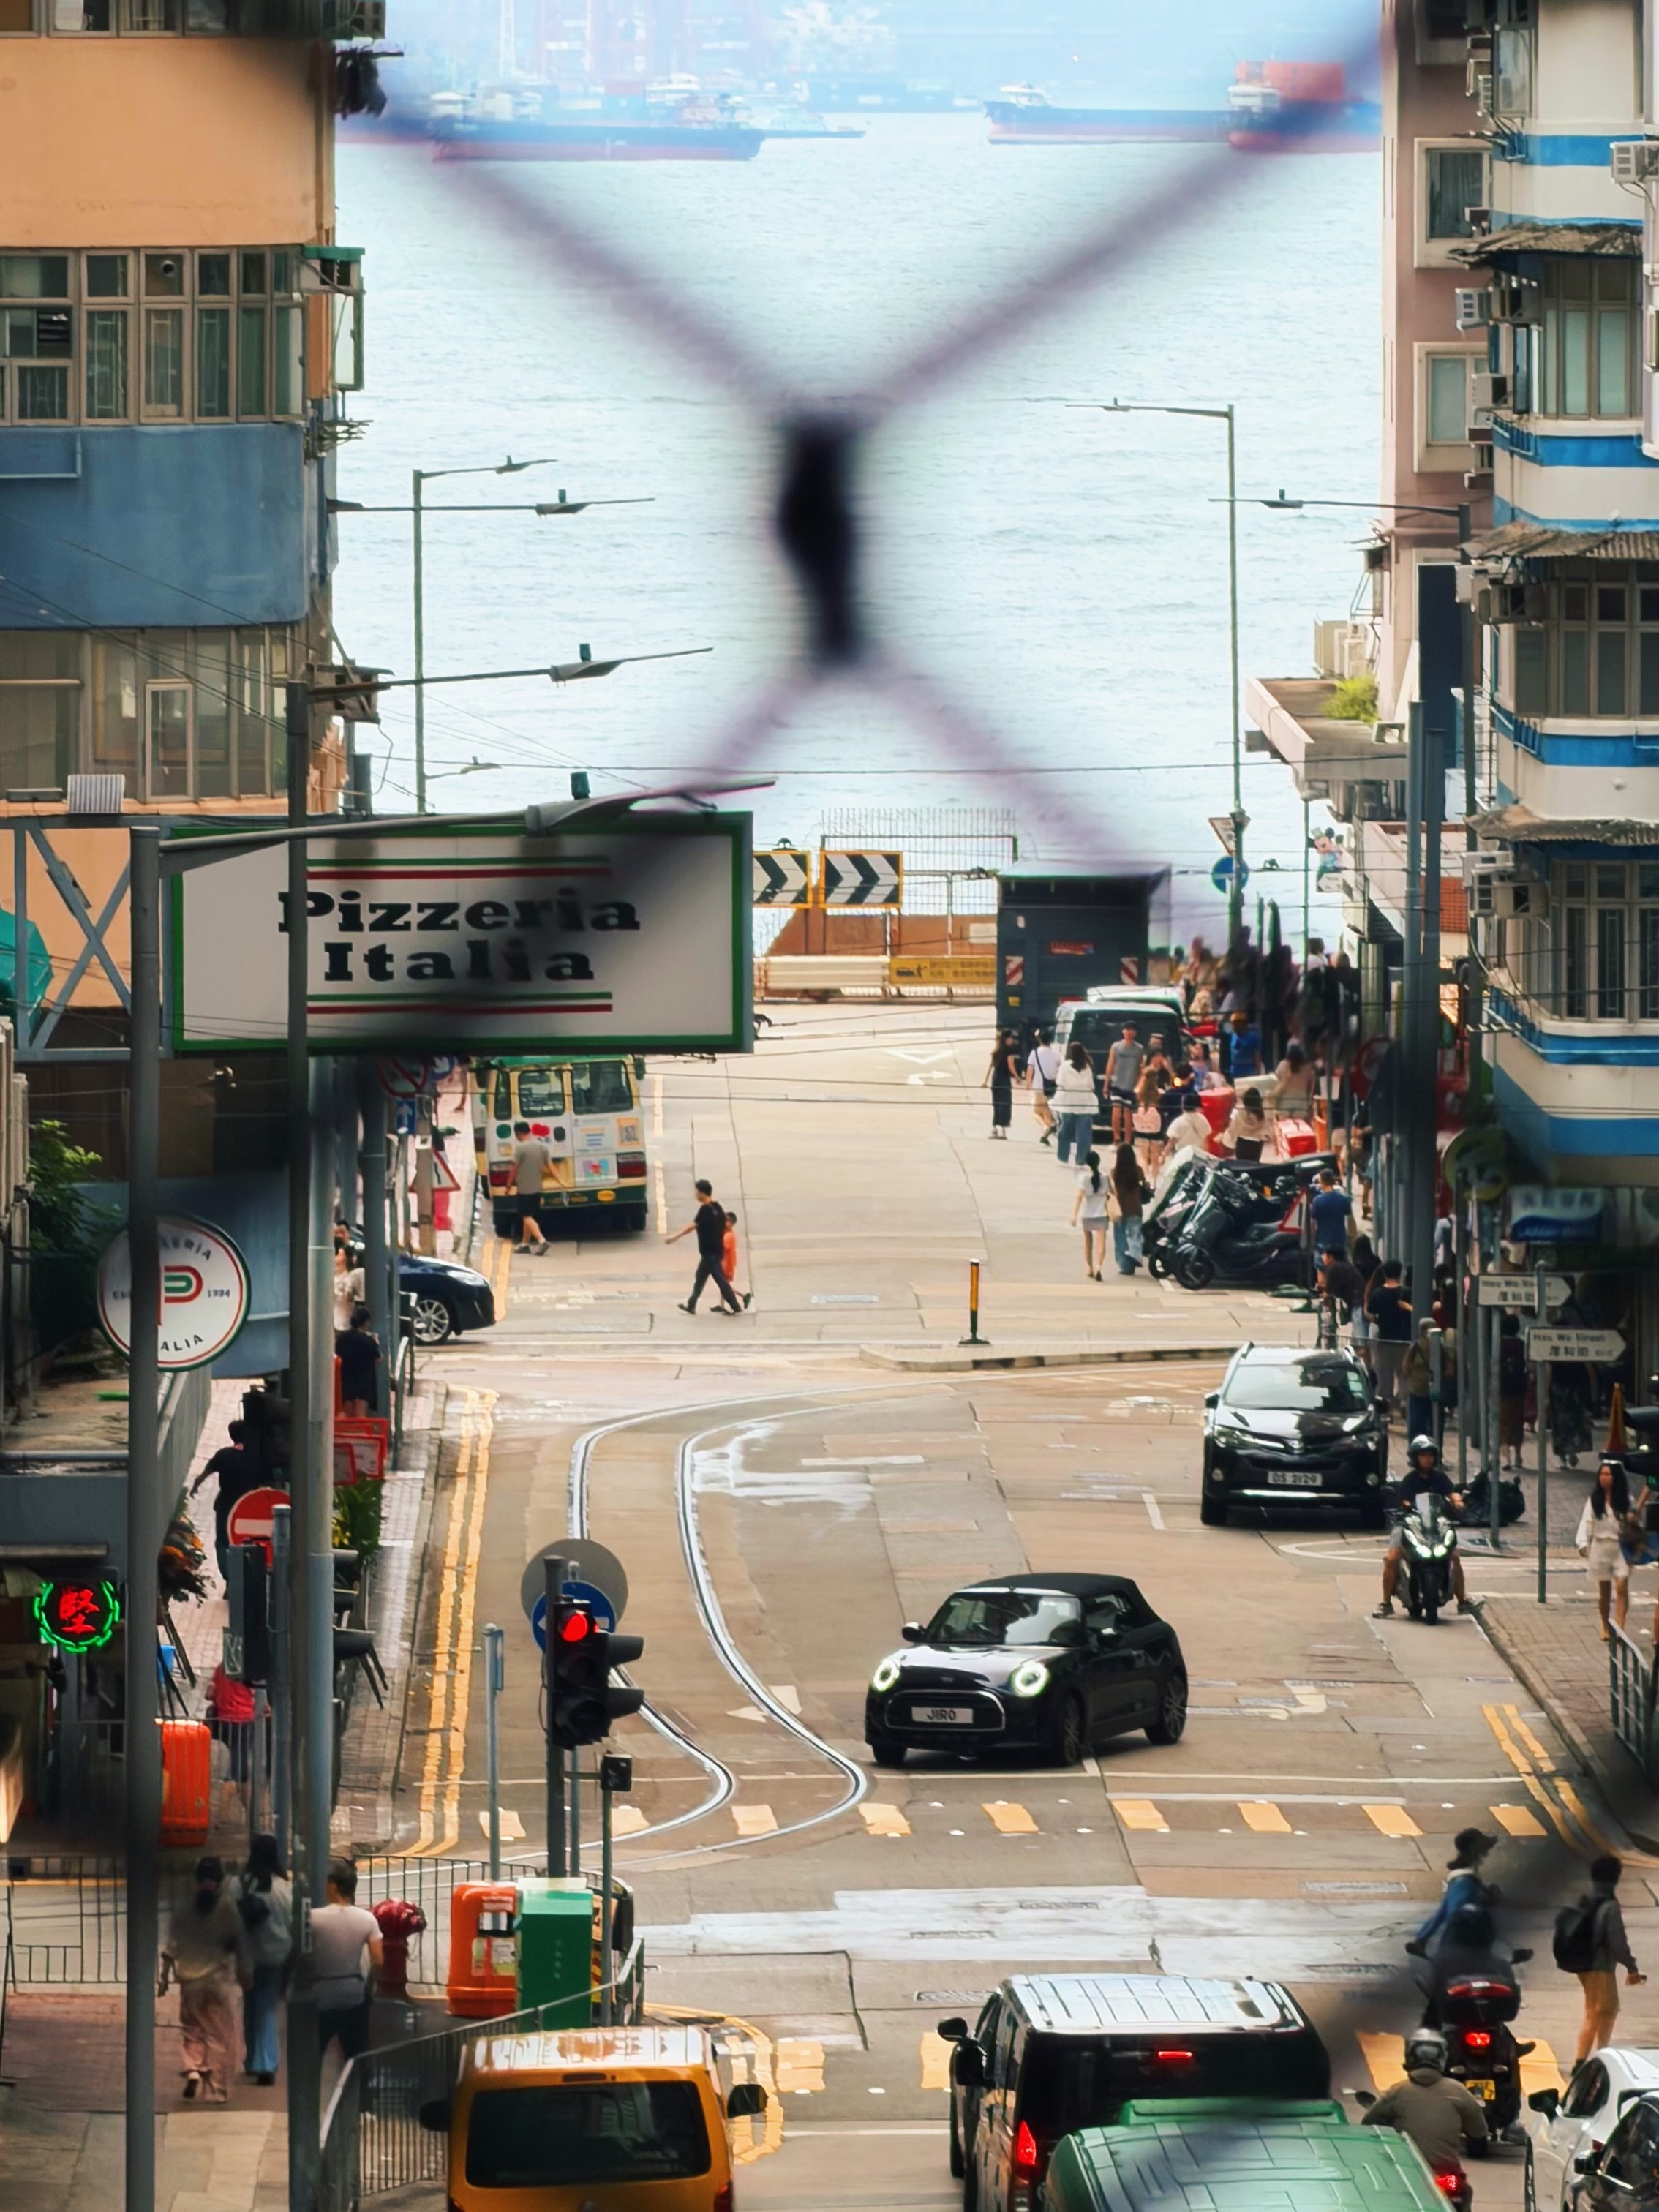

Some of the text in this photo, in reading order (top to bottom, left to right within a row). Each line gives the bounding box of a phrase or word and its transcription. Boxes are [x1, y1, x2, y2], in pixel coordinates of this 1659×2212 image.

[278, 887, 640, 933] Pizzeria
[324, 938, 594, 982] Italia
[160, 1334, 203, 1352] ALIA
[926, 1709, 956, 1721] JIRO
